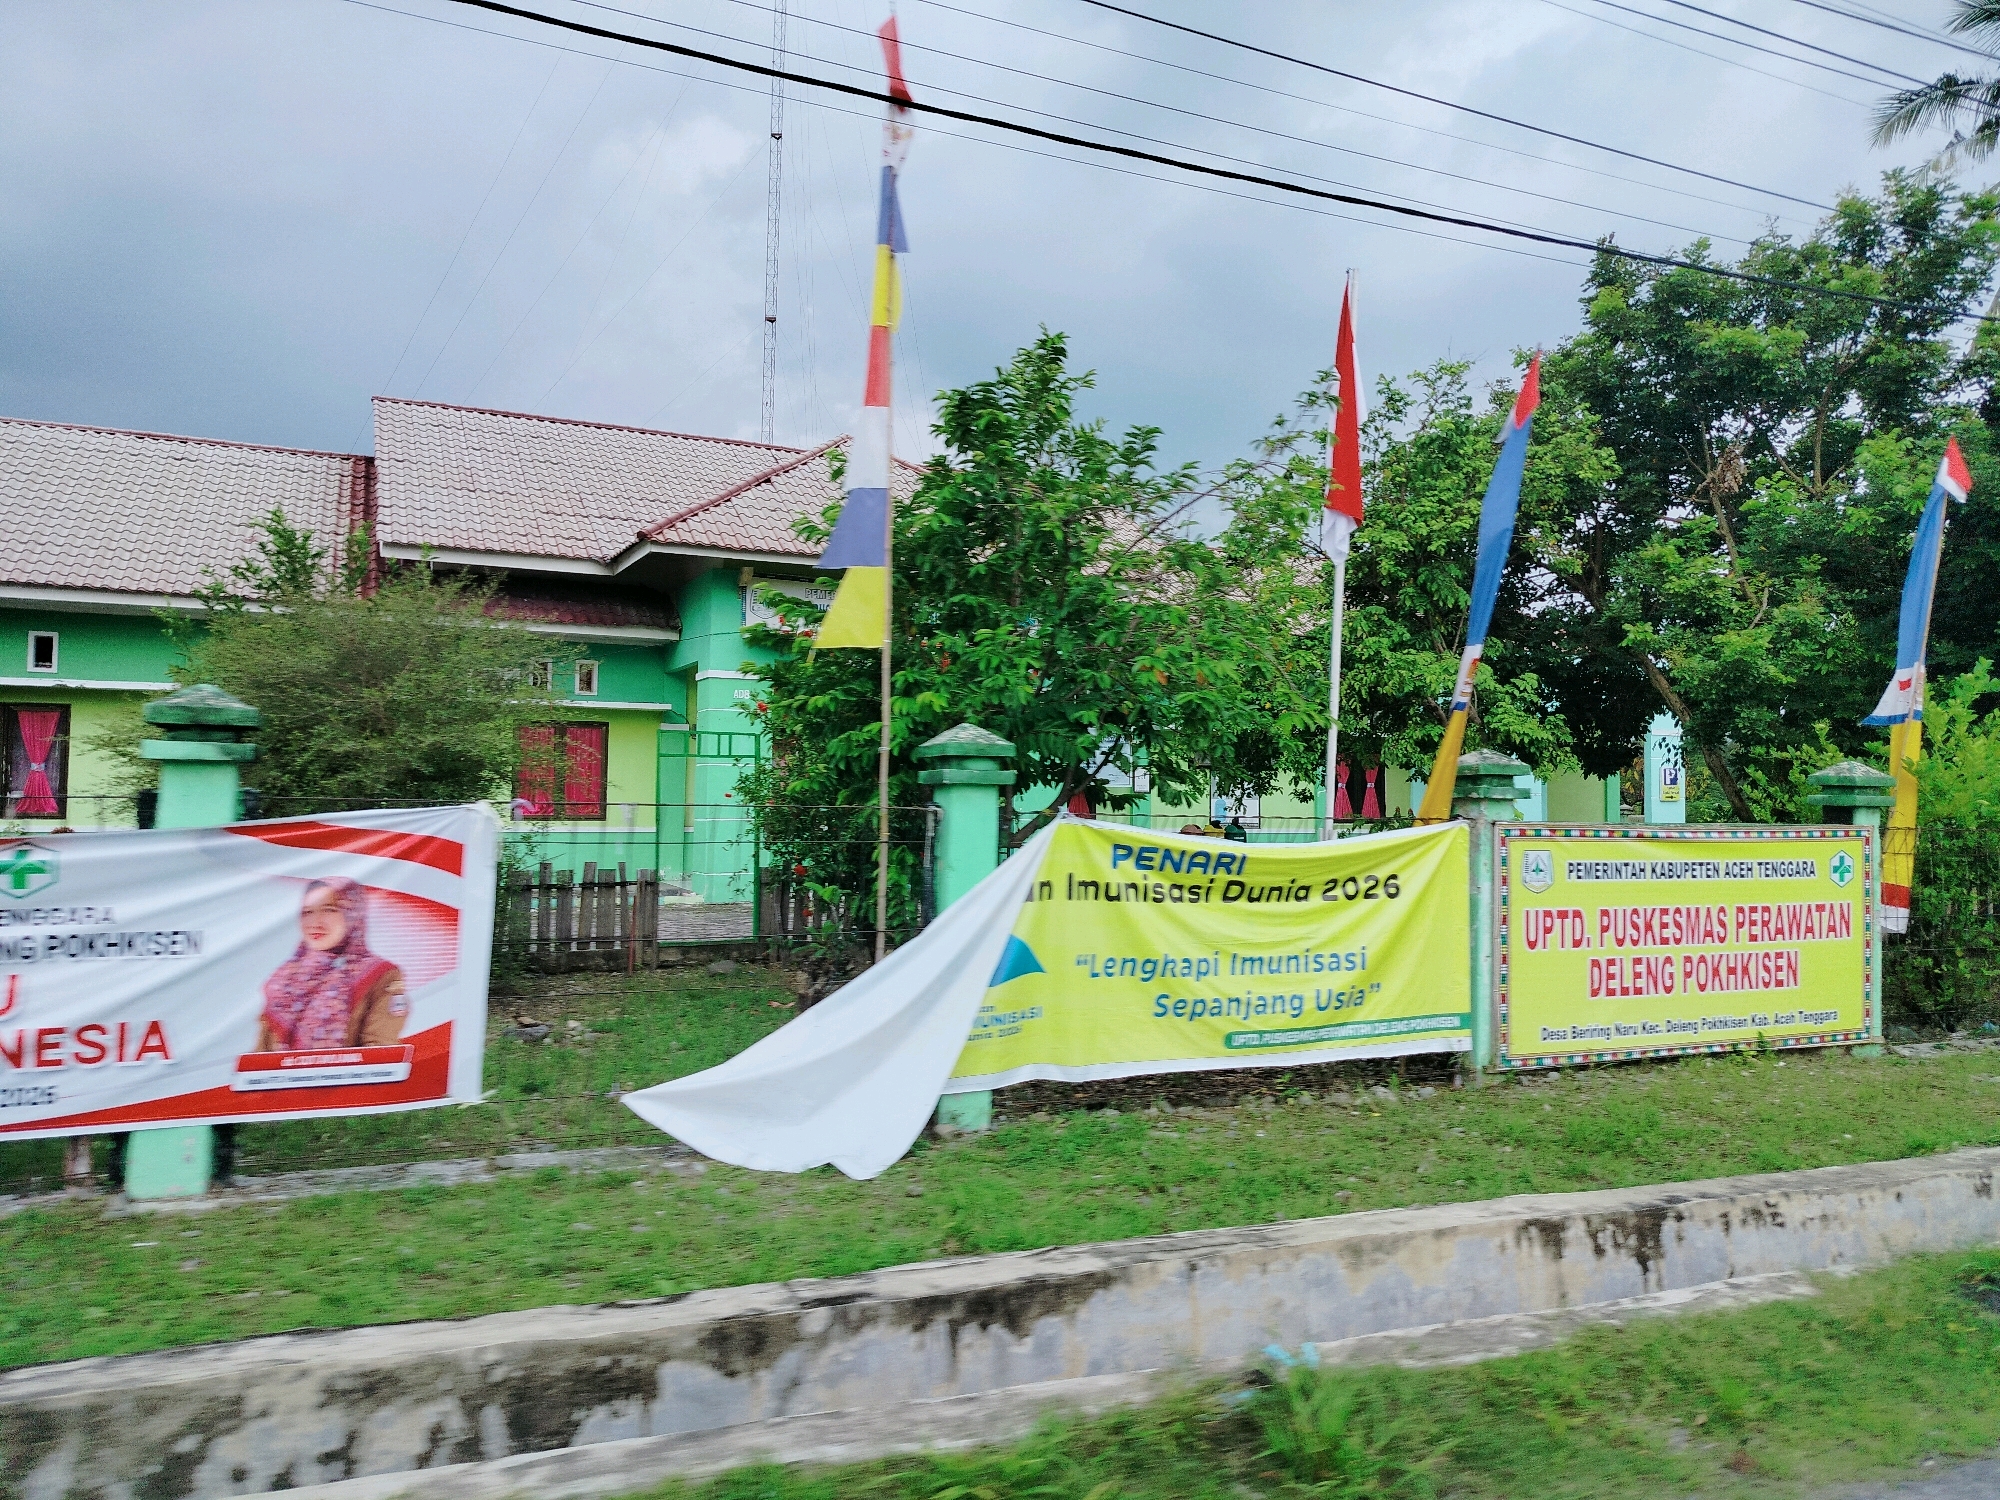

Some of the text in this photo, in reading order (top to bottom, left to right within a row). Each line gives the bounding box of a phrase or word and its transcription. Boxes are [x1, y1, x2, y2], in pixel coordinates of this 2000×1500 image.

[1112, 843, 1248, 876] PENARI
[1567, 860, 1816, 880] PEMERINTAH KABUPETEN ACEH TENGGARA
[1067, 872, 1216, 904] Imunisasi
[1221, 877, 1312, 904] Dunia
[1321, 873, 1402, 902] 2026
[1525, 902, 1851, 951] UPTD. PUSKESMAS PERAWATAN
[44, 929, 204, 959] POKHKISEN
[1230, 945, 1369, 977] Imunisasi
[1589, 950, 1799, 998] DELENG POKHKISEN
[1152, 990, 1306, 1022] Sepanjang
[1541, 1027, 1568, 1041] Desa
[1641, 1020, 1664, 1035] Kec.
[1665, 1019, 1699, 1035] Deleng
[1701, 1015, 1749, 1031] Pokhkisen
[1751, 1013, 1772, 1027] Kab.
[1774, 1012, 1796, 1026] Aceh
[1798, 1010, 1838, 1025] Tenggara
[0, 1019, 171, 1070] NESIA
